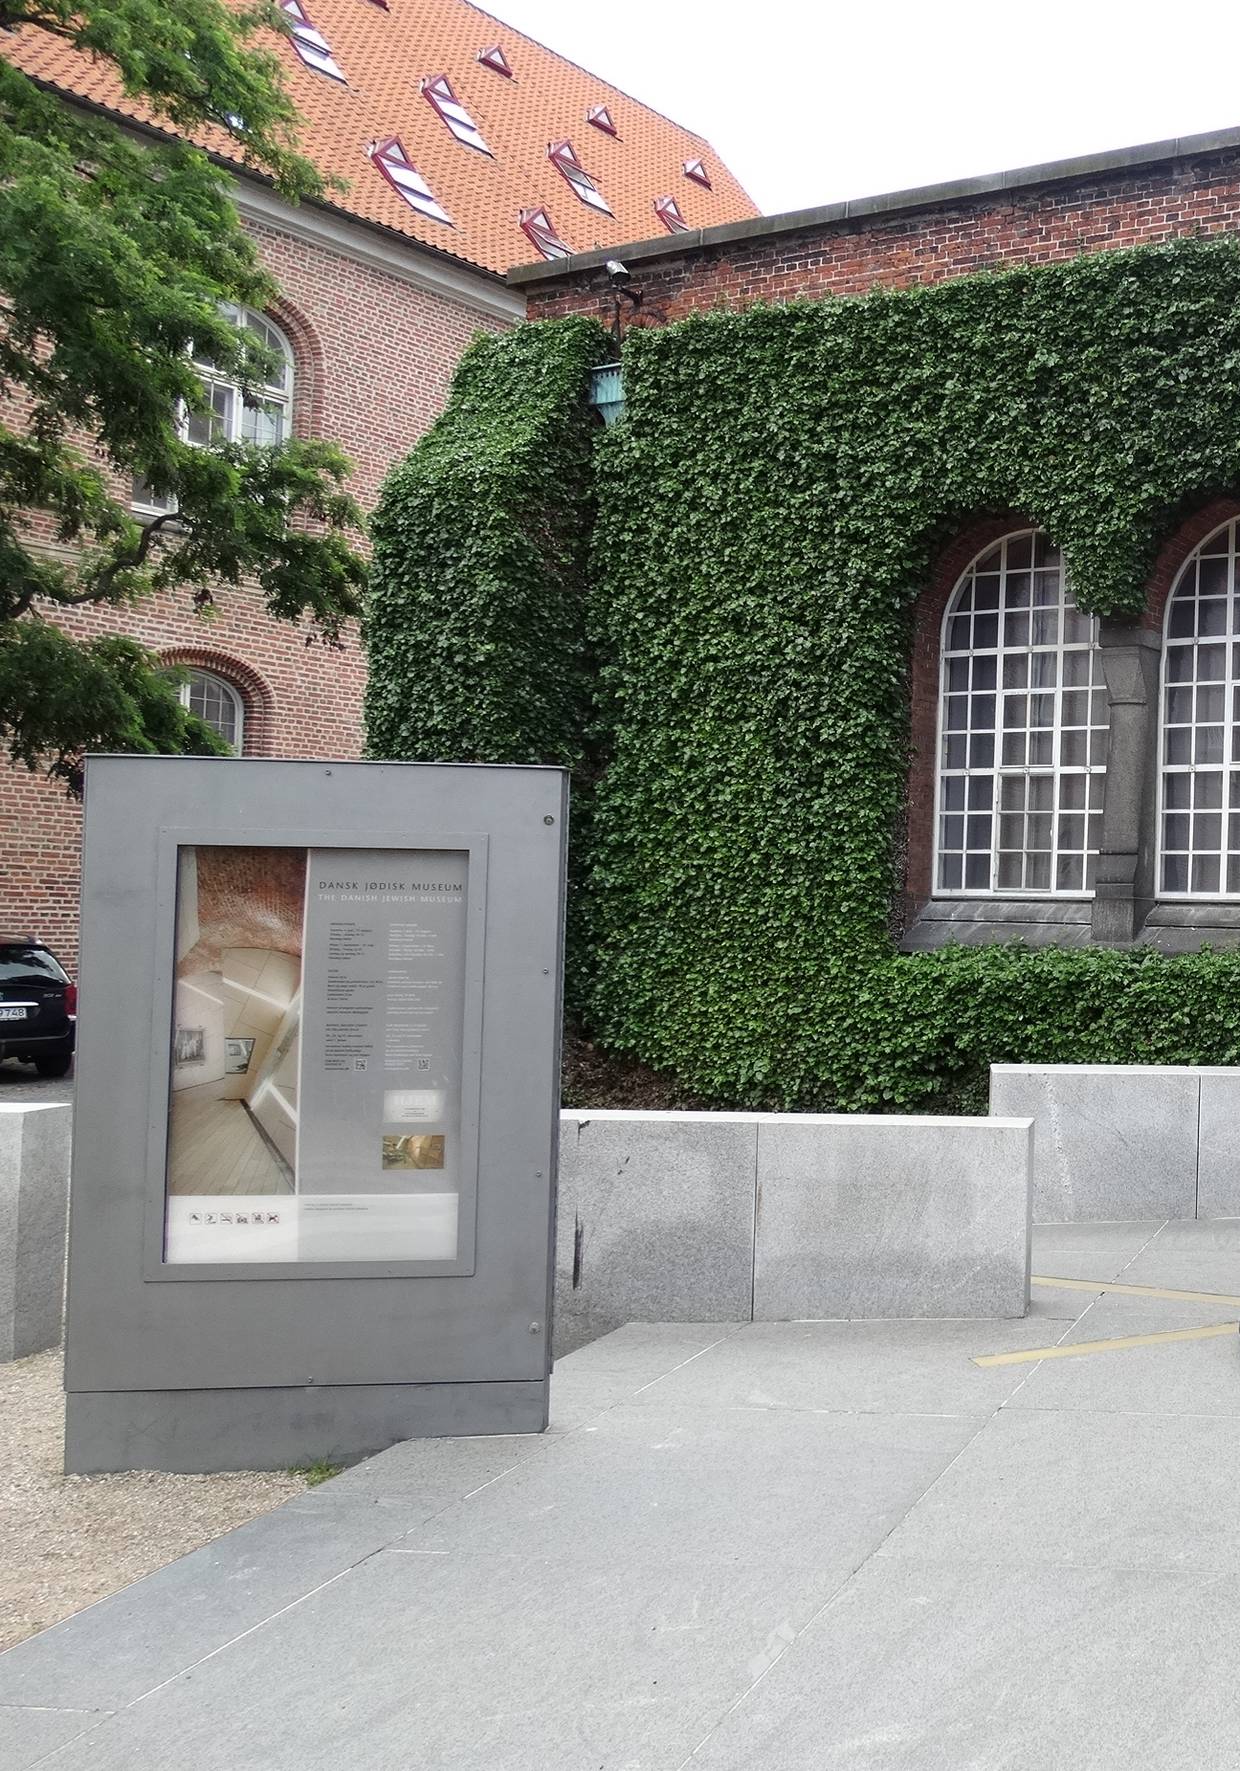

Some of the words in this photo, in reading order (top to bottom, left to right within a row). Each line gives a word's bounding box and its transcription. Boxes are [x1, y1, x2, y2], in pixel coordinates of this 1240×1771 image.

[319, 881, 359, 890] DANSK
[365, 881, 405, 892] JØDISK
[411, 882, 463, 892] MUSEUM
[340, 894, 378, 902] DANISH
[382, 895, 416, 903] JEWISH
